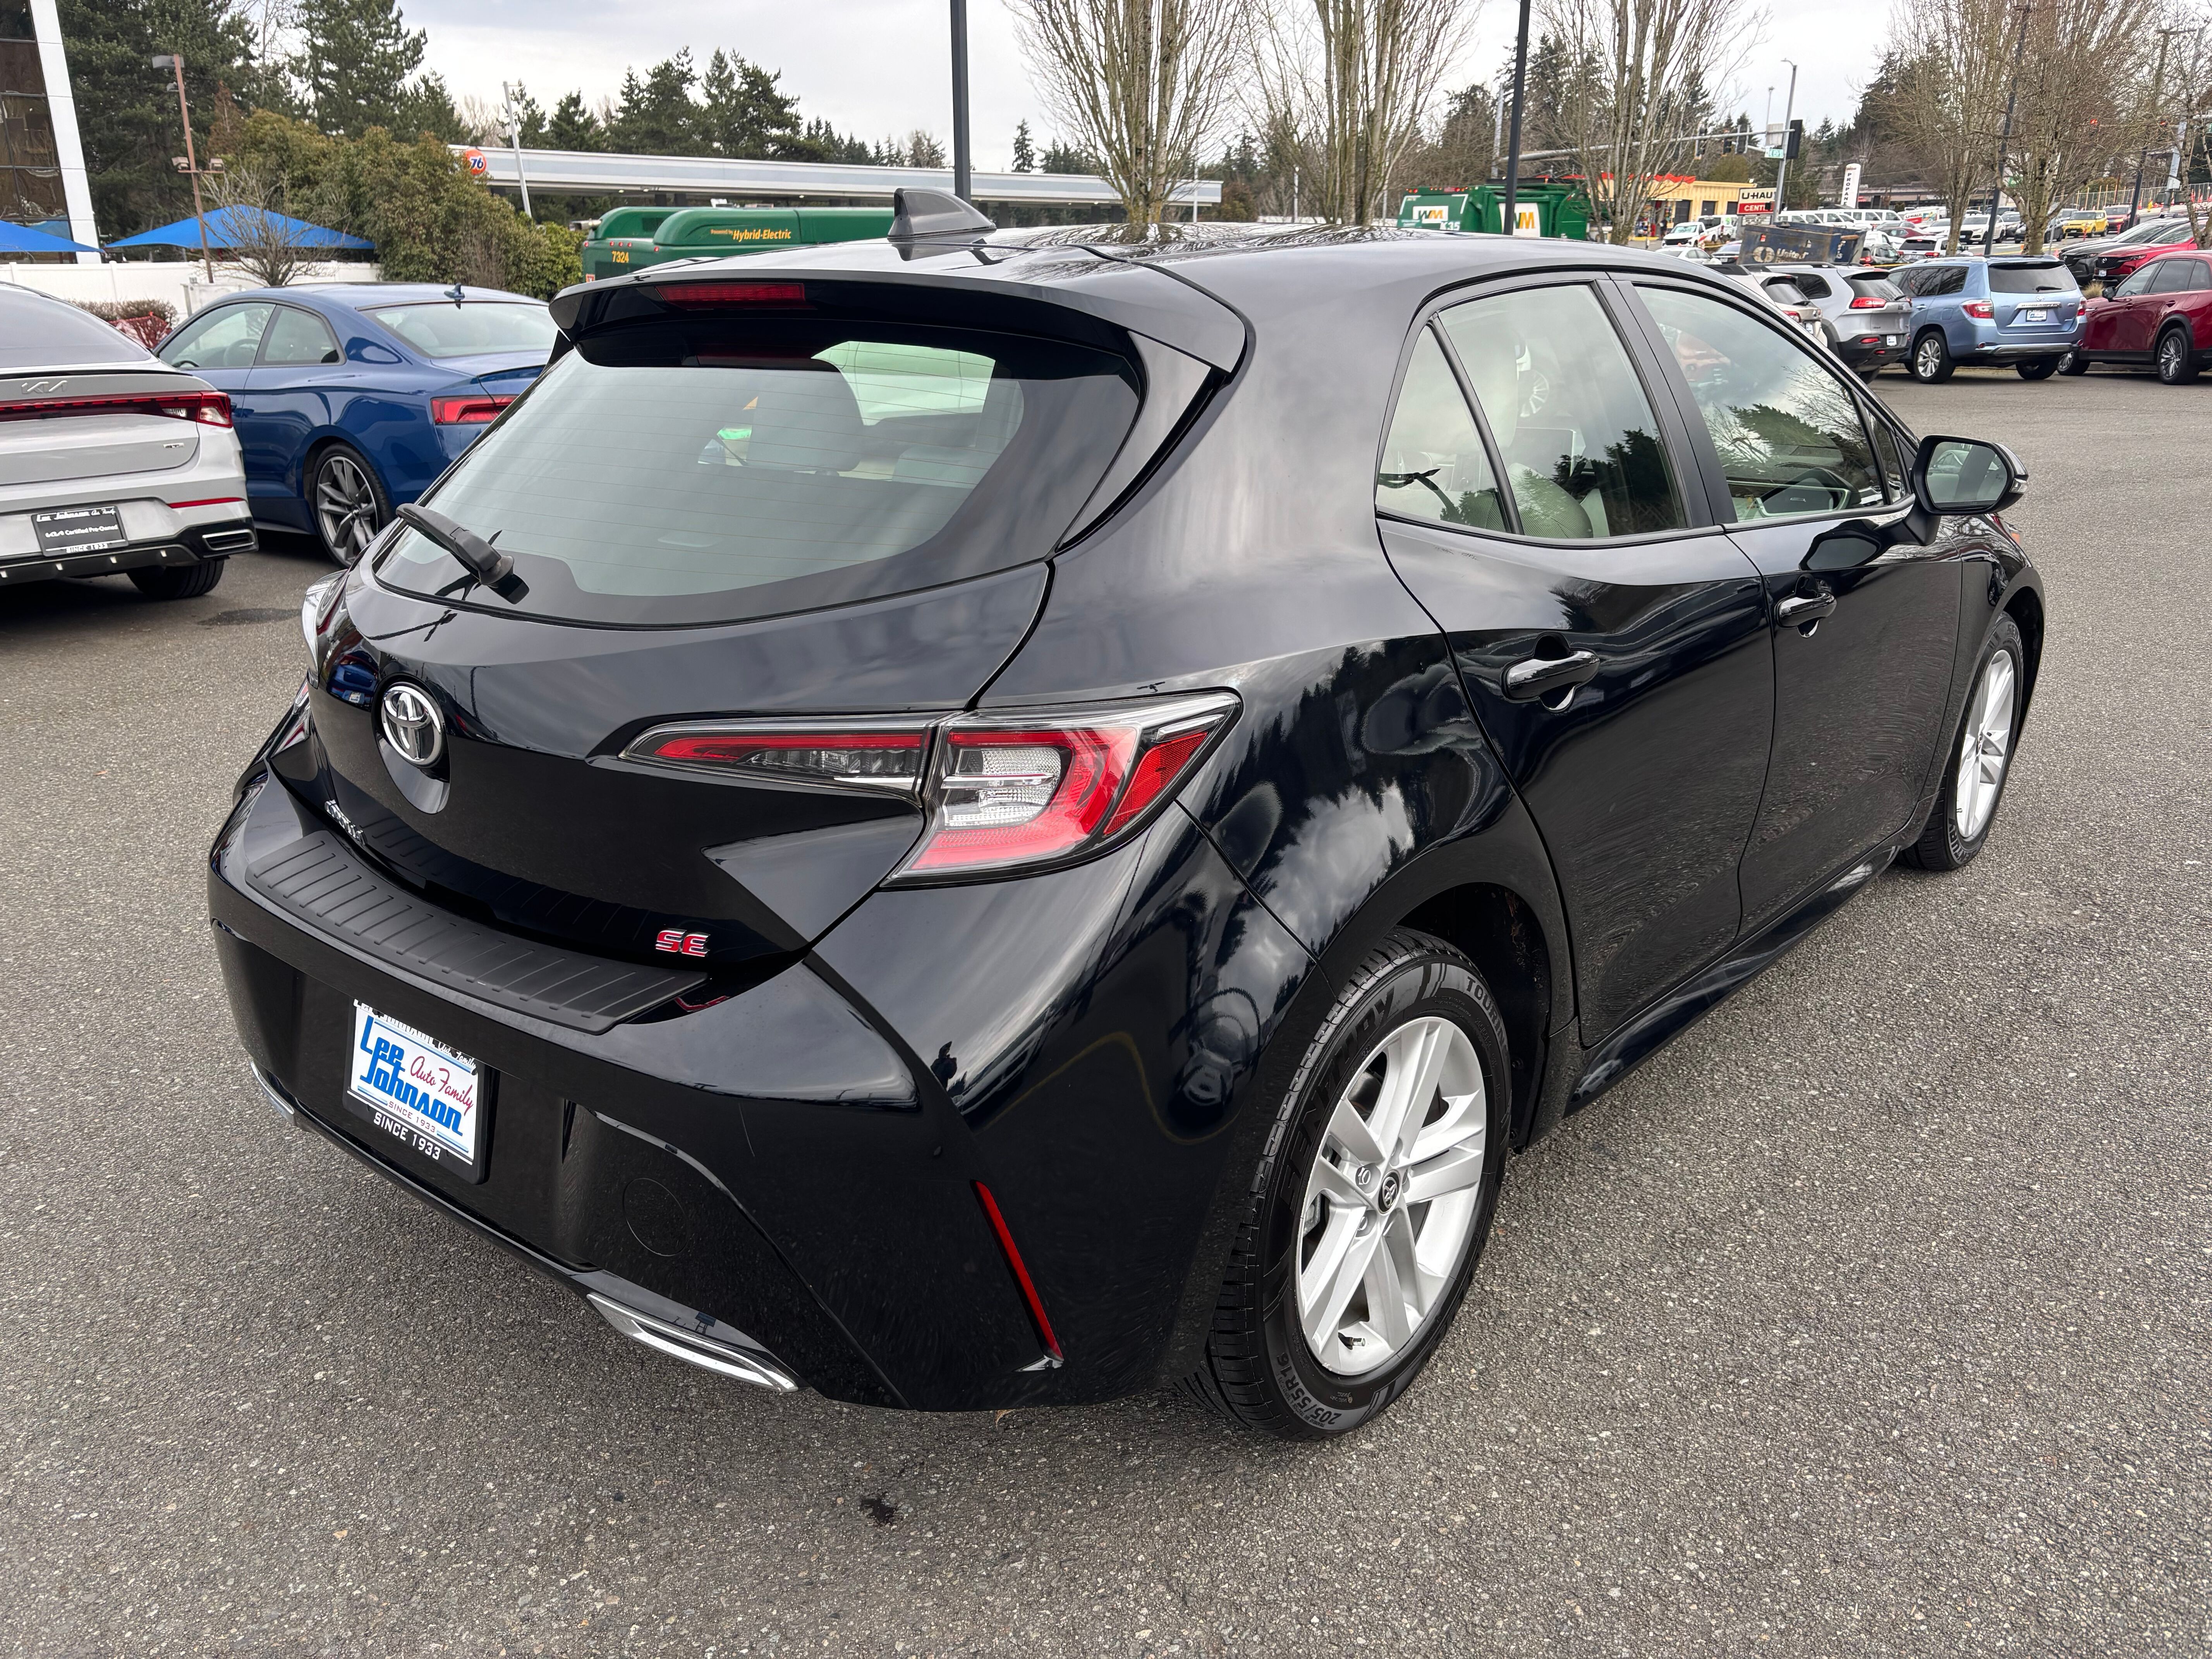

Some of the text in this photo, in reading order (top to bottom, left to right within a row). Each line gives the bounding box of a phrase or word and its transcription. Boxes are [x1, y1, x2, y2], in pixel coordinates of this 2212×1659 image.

[471, 157, 484, 169] 76
[1844, 173, 1852, 205] PROPANE
[1419, 210, 1443, 219] WM
[733, 229, 792, 242] Hybrid-Electric
[655, 927, 711, 957] SE
[360, 1015, 405, 1062] Lee
[410, 1056, 436, 1086] Auto
[439, 1068, 474, 1116] Family
[360, 1052, 463, 1137] Johnson
[388, 1101, 436, 1133] SINCE 1933
[373, 1111, 441, 1160] SINCE 1933
[1276, 1352, 1342, 1425] 205/55R16
